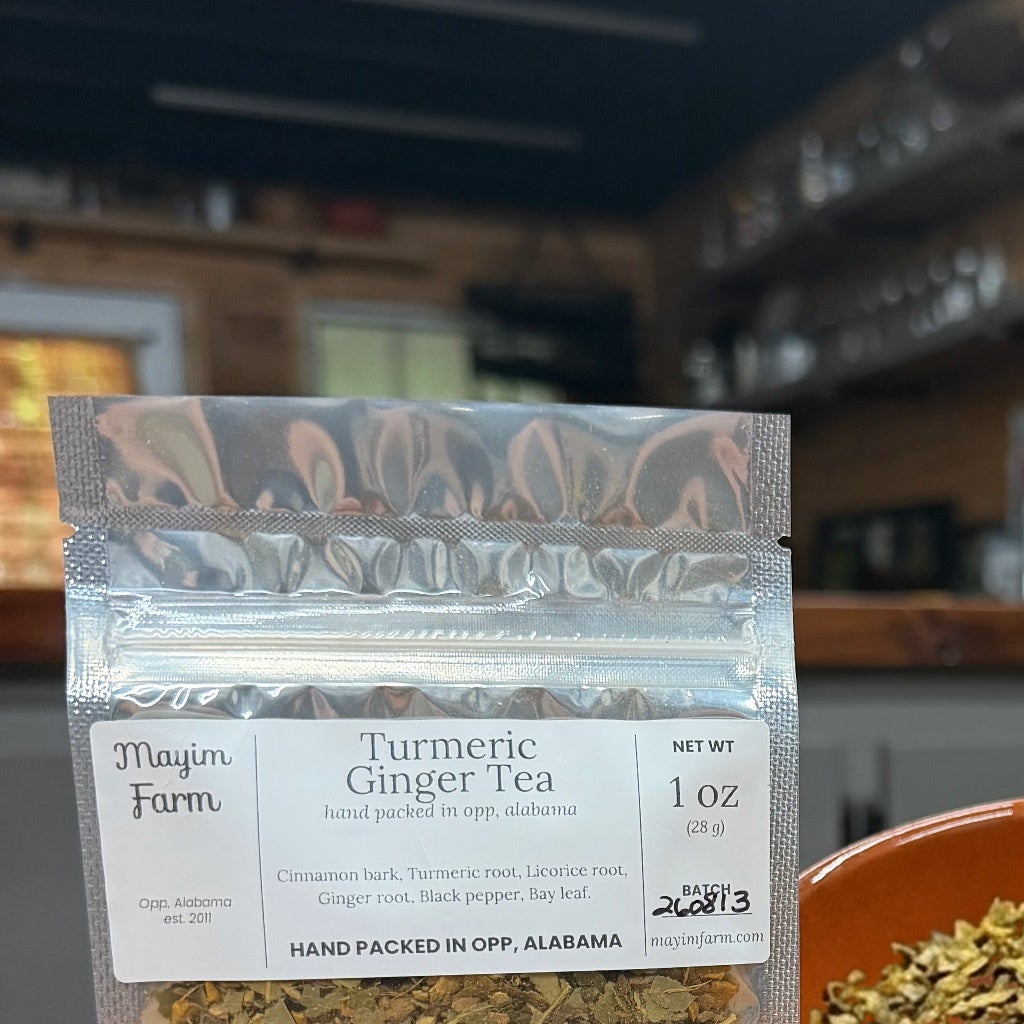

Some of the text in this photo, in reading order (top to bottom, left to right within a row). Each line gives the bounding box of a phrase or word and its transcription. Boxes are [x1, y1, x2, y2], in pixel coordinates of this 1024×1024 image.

[360, 730, 538, 762] Turmeric
[672, 740, 735, 753] NET WT
[113, 740, 232, 779] Mayim
[346, 764, 555, 804] Ginger Tea
[669, 775, 739, 808] 1 oz
[129, 783, 222, 820] Farm
[324, 801, 577, 823] hand packed in opp, alabama
[686, 819, 725, 838] (28 g)
[277, 862, 628, 883] Cinnamon bark, Turmeric root, Licorice root,
[318, 885, 591, 908] Ginger root, Black pepper, Bay leaf.
[682, 883, 731, 896] BATCH
[139, 896, 232, 911] Opp, Alabama
[651, 890, 751, 917] 260813
[164, 912, 212, 924] est. 2011
[290, 934, 622, 957] HAND PACKED IN OPP, ALABAMA
[651, 931, 764, 950] mayimfarm.com
